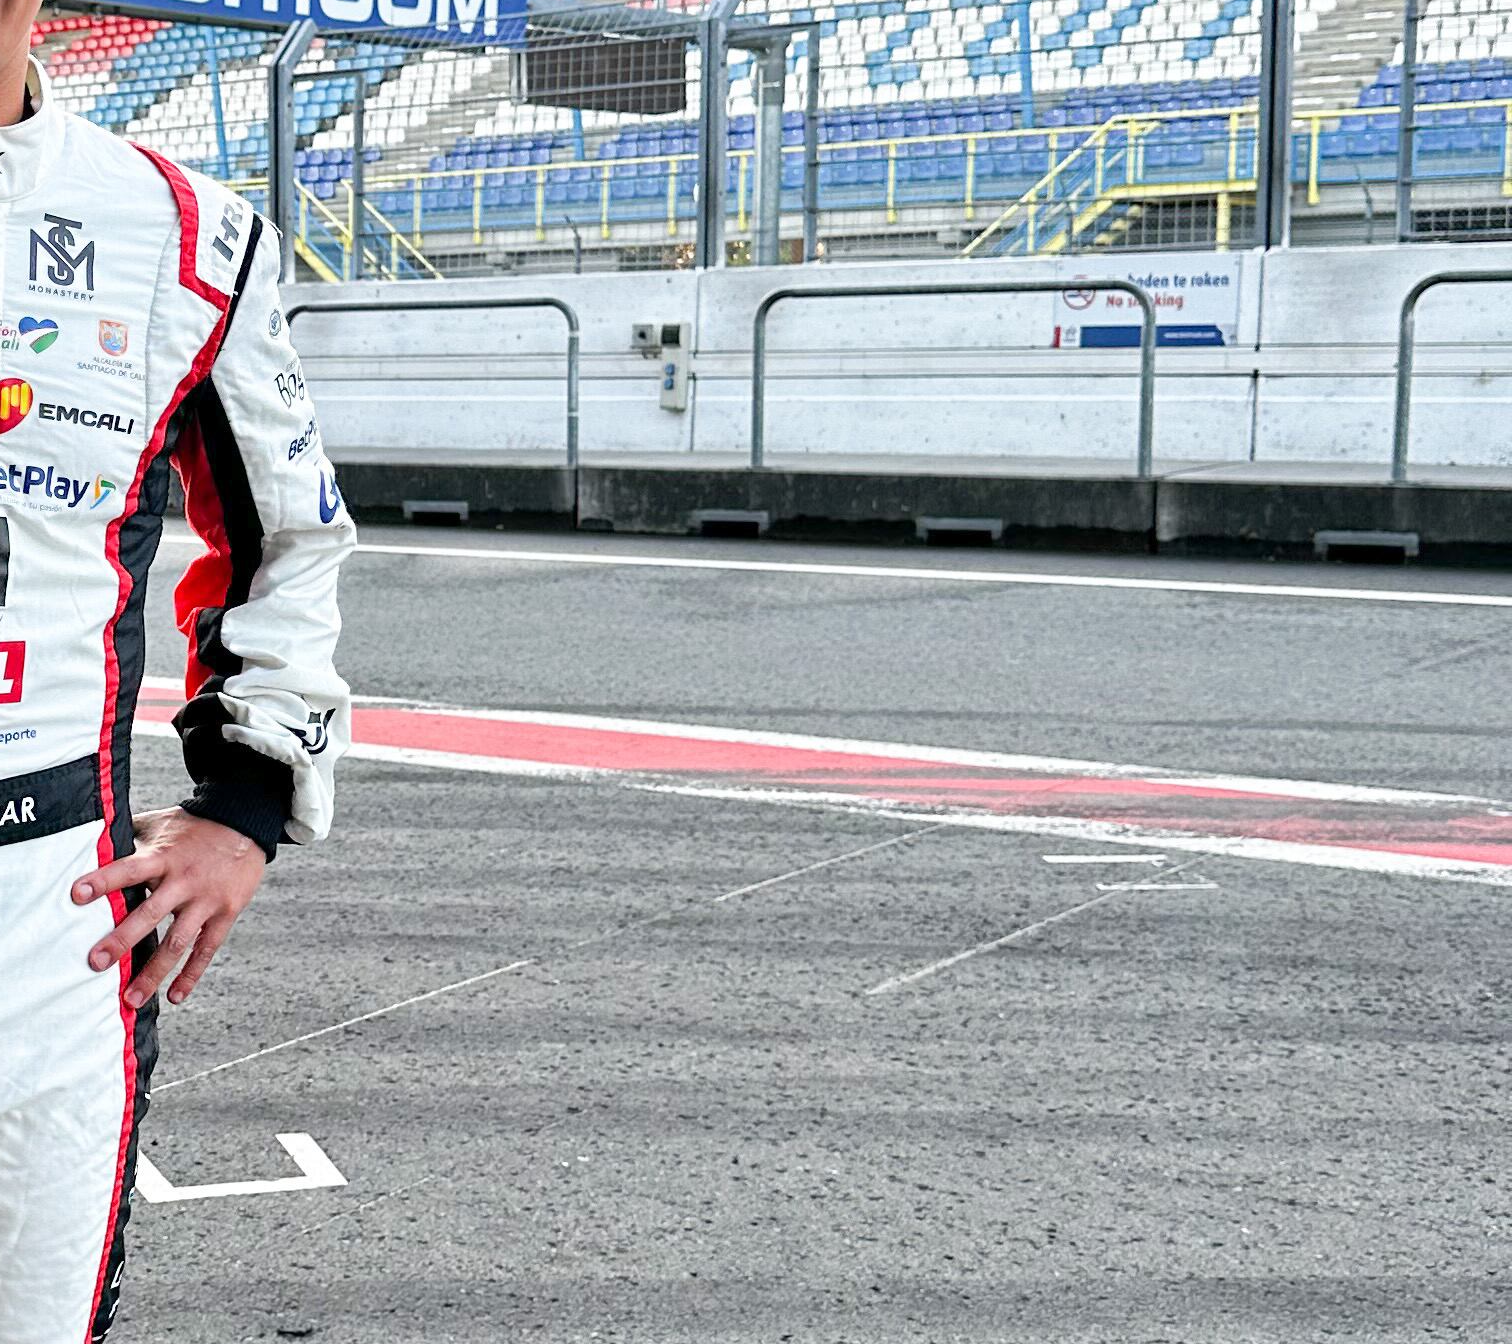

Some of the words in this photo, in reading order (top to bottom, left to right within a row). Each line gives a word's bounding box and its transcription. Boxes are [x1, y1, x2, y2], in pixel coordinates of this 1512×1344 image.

[1190, 271, 1230, 287] roken
[28, 284, 95, 302] MONASTERY
[38, 402, 135, 435] EMCALI
